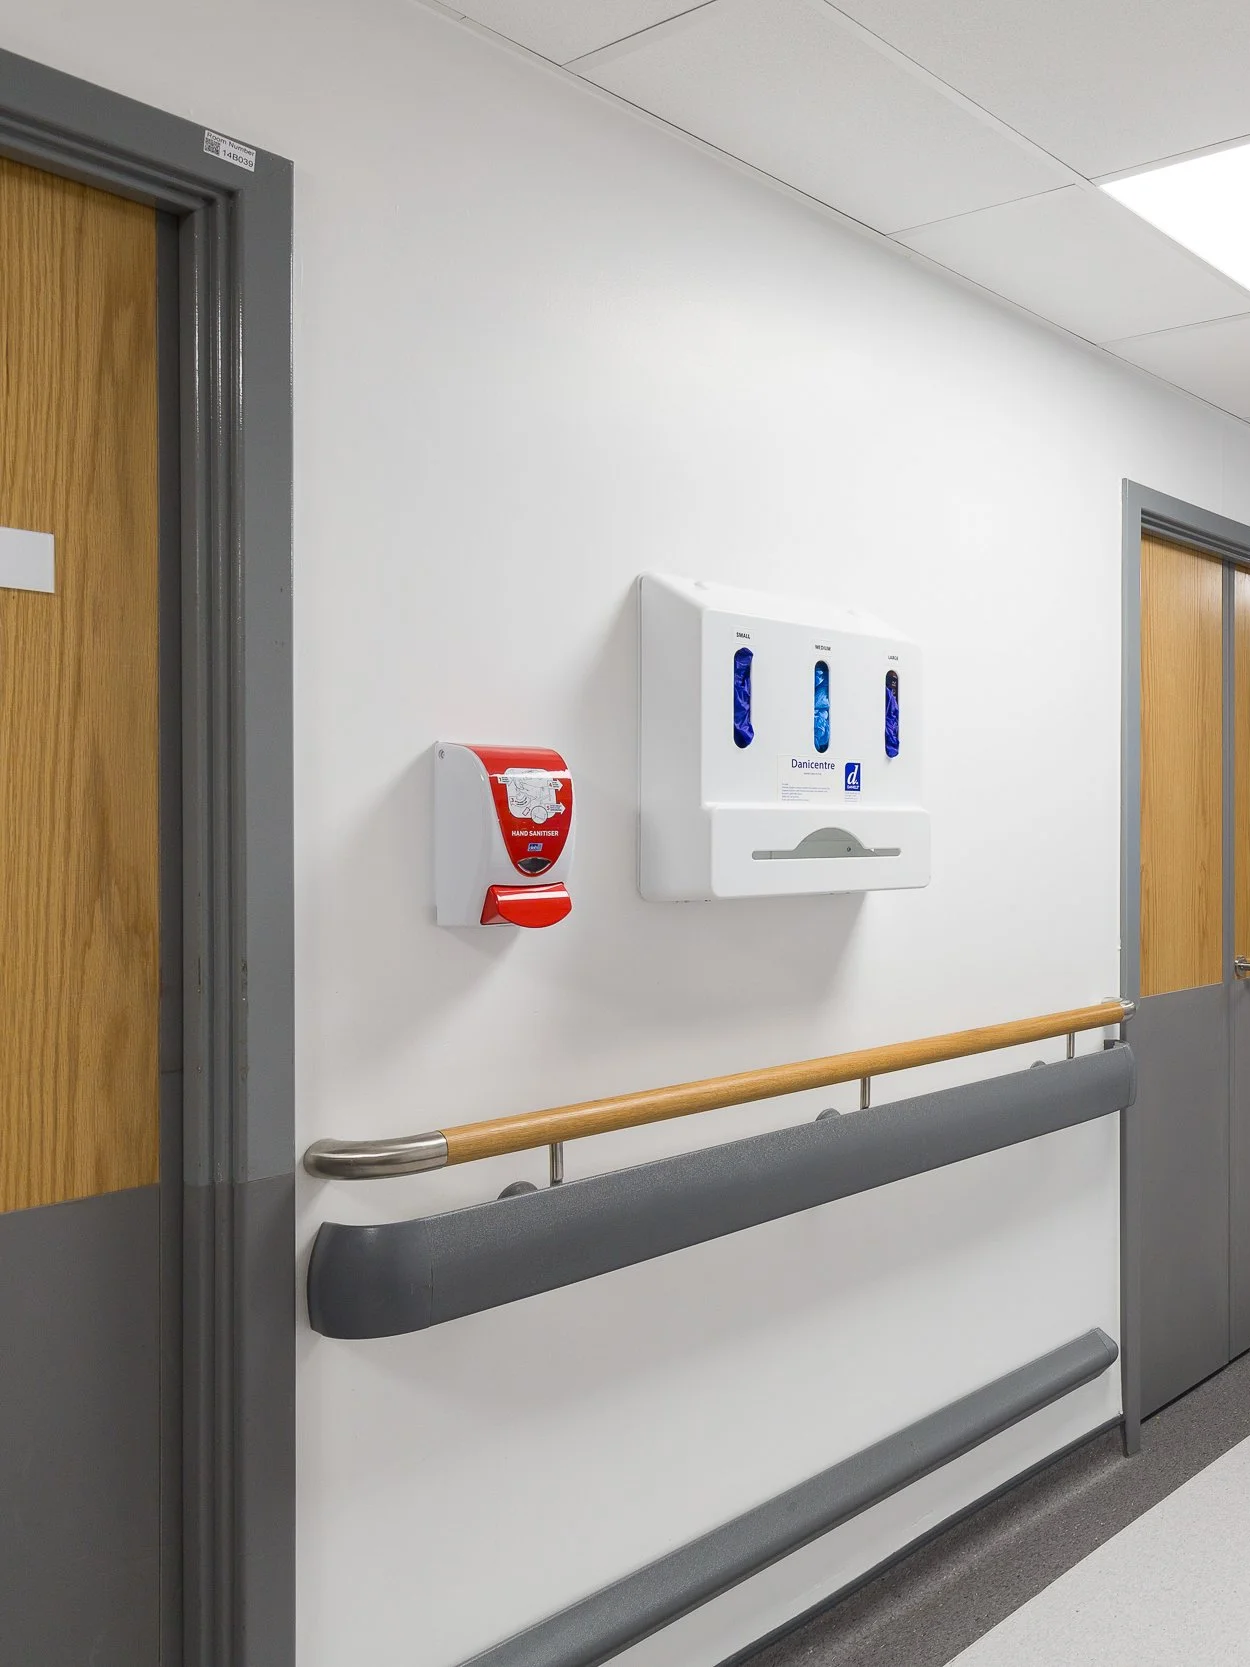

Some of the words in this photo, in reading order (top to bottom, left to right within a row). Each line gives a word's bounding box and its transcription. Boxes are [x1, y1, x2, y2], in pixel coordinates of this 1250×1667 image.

[207, 132, 226, 144] Room
[229, 141, 254, 156] Number
[223, 149, 254, 167] 14B039
[736, 632, 751, 640] SMALL
[791, 758, 836, 770] Danicentre
